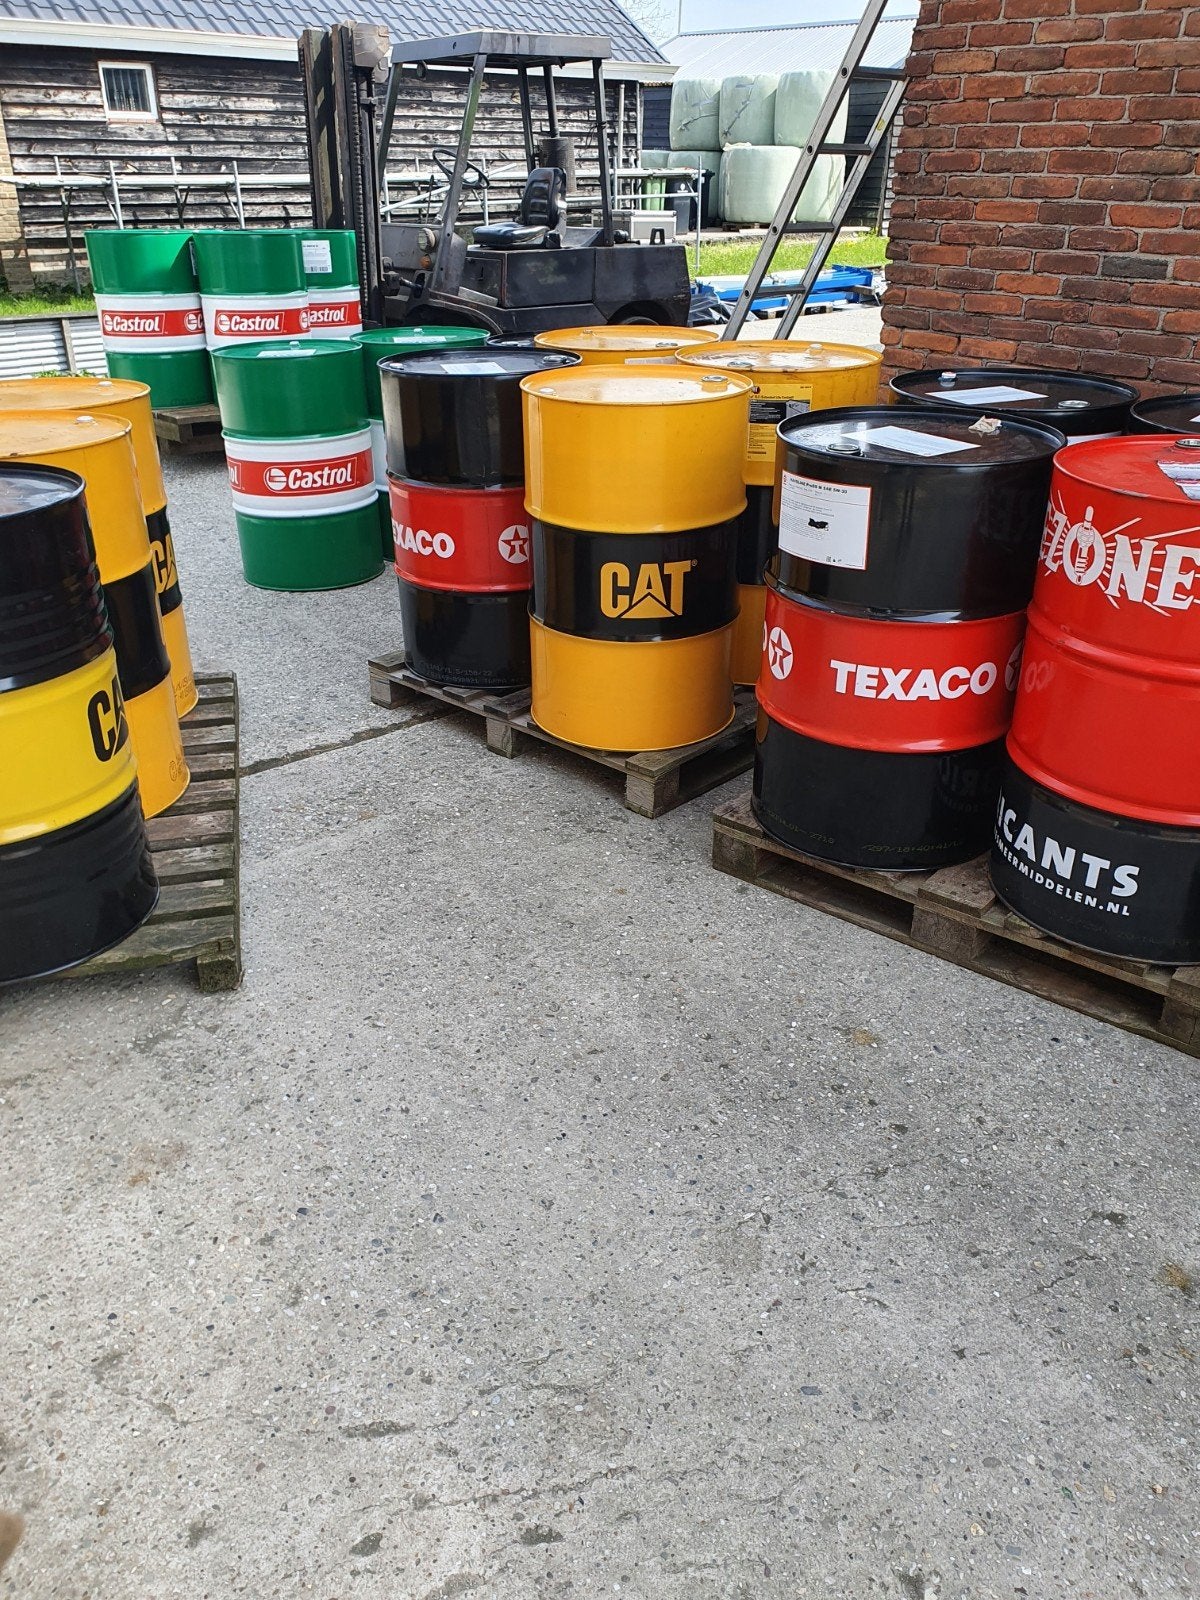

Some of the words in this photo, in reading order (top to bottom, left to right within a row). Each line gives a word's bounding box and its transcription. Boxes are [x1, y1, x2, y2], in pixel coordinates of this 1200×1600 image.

[112, 315, 160, 332] Castrol
[230, 314, 279, 332] Castrol
[309, 306, 346, 323] astrol
[288, 463, 353, 489] Castrol
[391, 517, 456, 559] EXACO
[152, 534, 176, 593] CA
[600, 559, 692, 619] CAT
[830, 660, 998, 701] TEXACO
[88, 673, 129, 762] CA
[997, 789, 1140, 898] ICANTS
